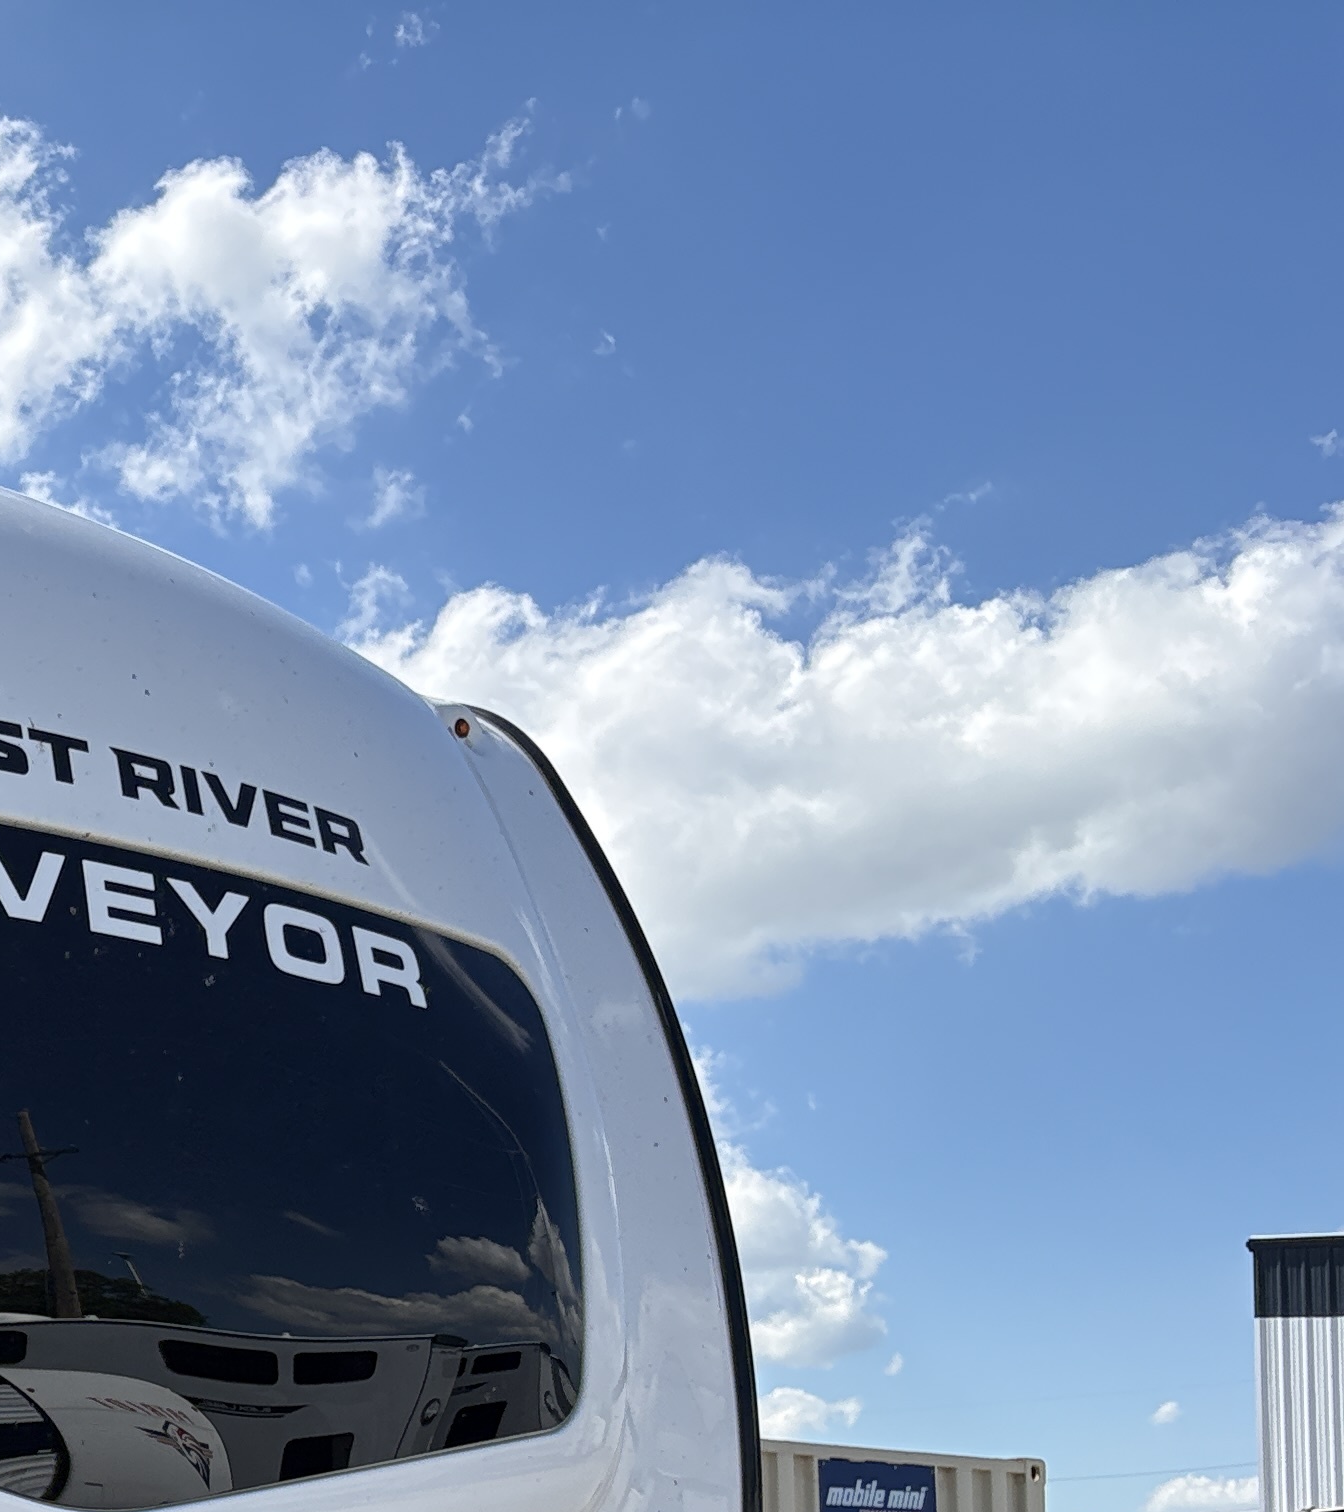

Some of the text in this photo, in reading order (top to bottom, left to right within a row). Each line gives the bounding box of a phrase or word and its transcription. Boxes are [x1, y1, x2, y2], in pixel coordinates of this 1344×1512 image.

[109, 744, 370, 866] RIVER
[826, 1478, 927, 1510] mobile mini
